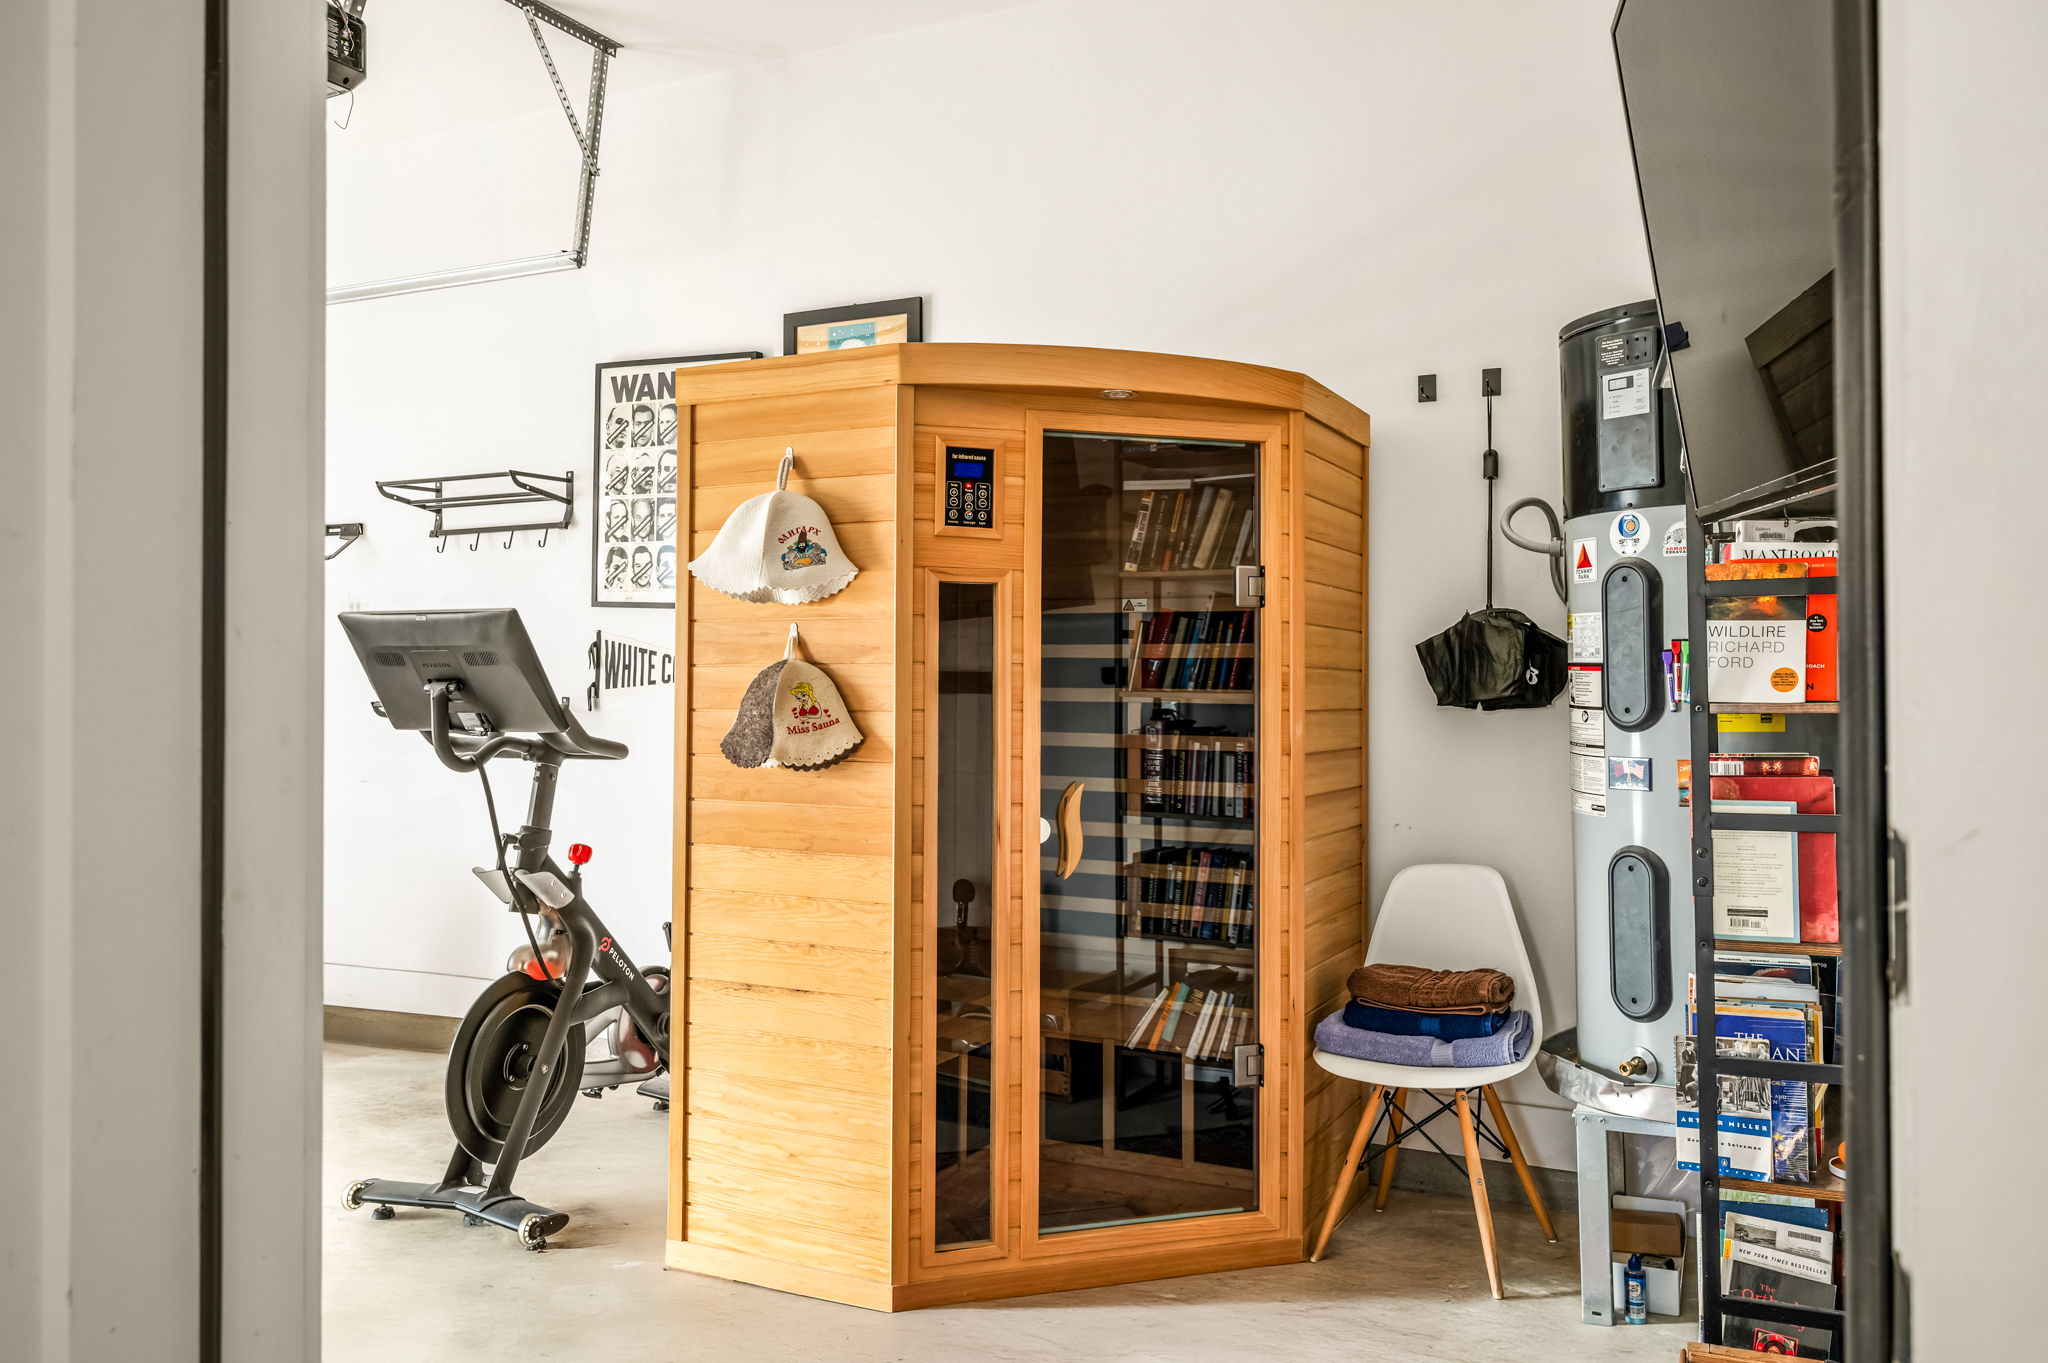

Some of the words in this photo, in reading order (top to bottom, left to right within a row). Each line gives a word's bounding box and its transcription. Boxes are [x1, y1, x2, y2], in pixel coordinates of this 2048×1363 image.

[605, 639, 657, 690] WHITE
[661, 653, 675, 684] C
[1708, 656, 1754, 669] FORD
[787, 725, 810, 735] Miss
[812, 718, 840, 732] Sauna
[608, 947, 635, 981] PELOTON
[1728, 1121, 1768, 1132] MILLER
[1754, 1252, 1768, 1260] YORK
[1771, 1257, 1789, 1265] TIMES
[1791, 1262, 1827, 1275] BESTSELLER
[1760, 1283, 1776, 1293] The
